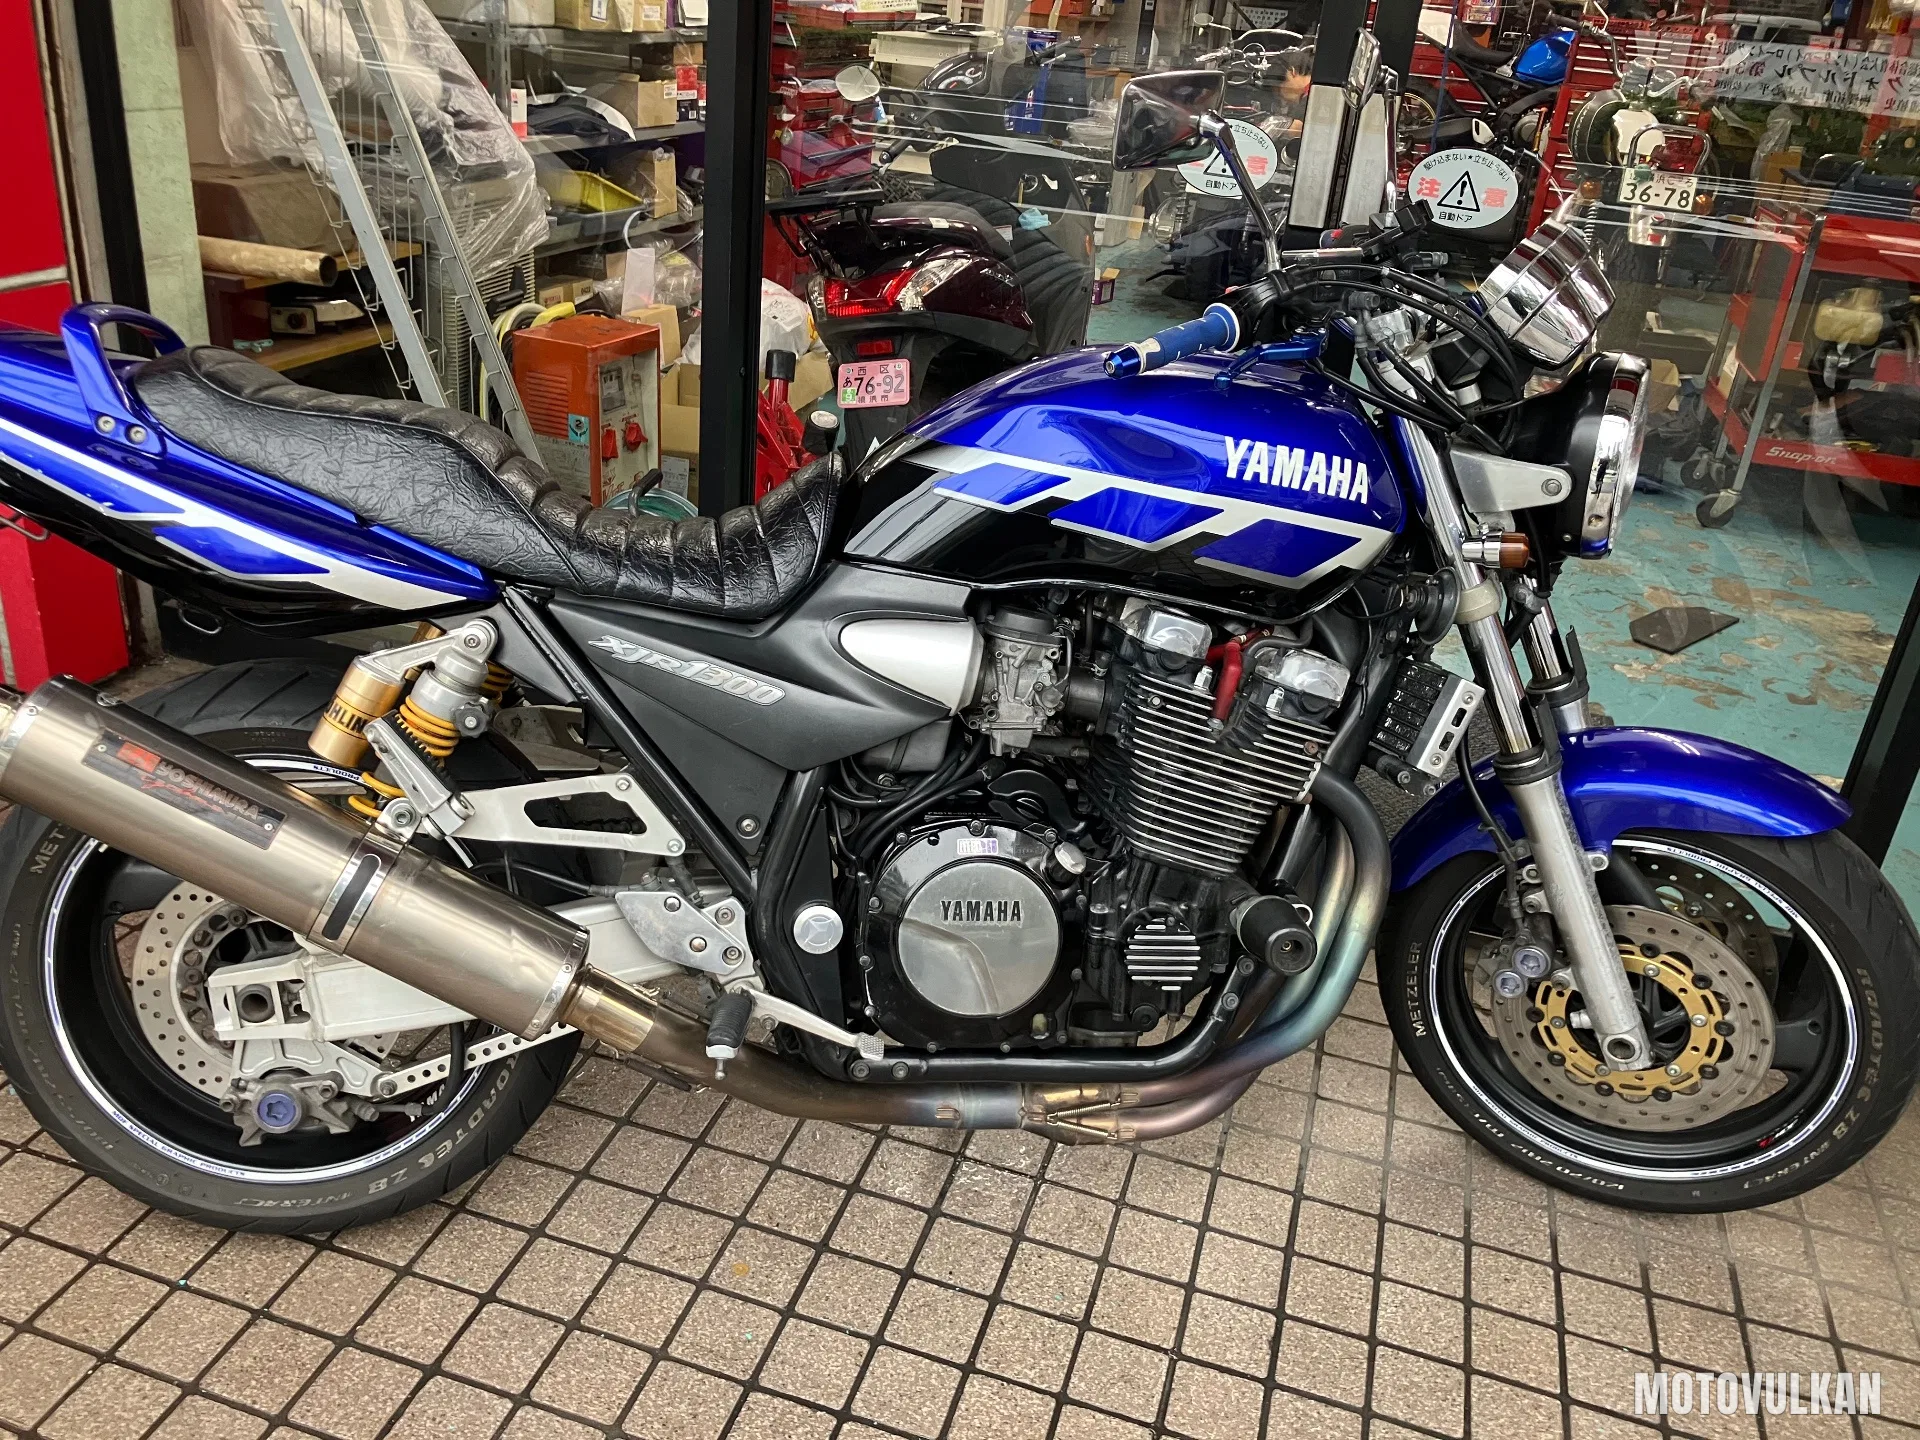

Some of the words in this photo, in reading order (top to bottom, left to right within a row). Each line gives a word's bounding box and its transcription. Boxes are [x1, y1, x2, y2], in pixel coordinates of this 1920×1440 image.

[1205, 179, 1238, 191] 自動ドア
[1623, 182, 1691, 208] 36-78
[1438, 211, 1473, 223] 自動ドア
[842, 377, 853, 388] あ
[853, 373, 905, 396] 76-92
[1765, 446, 1837, 465] Snap-on
[1224, 435, 1369, 505] YAMAHA
[588, 634, 785, 706] XJR1300
[327, 702, 369, 734] HLIN
[156, 761, 262, 821] YOSHIMURA
[941, 900, 1021, 922] YAMAHA
[1406, 941, 1427, 1037] METZELER
